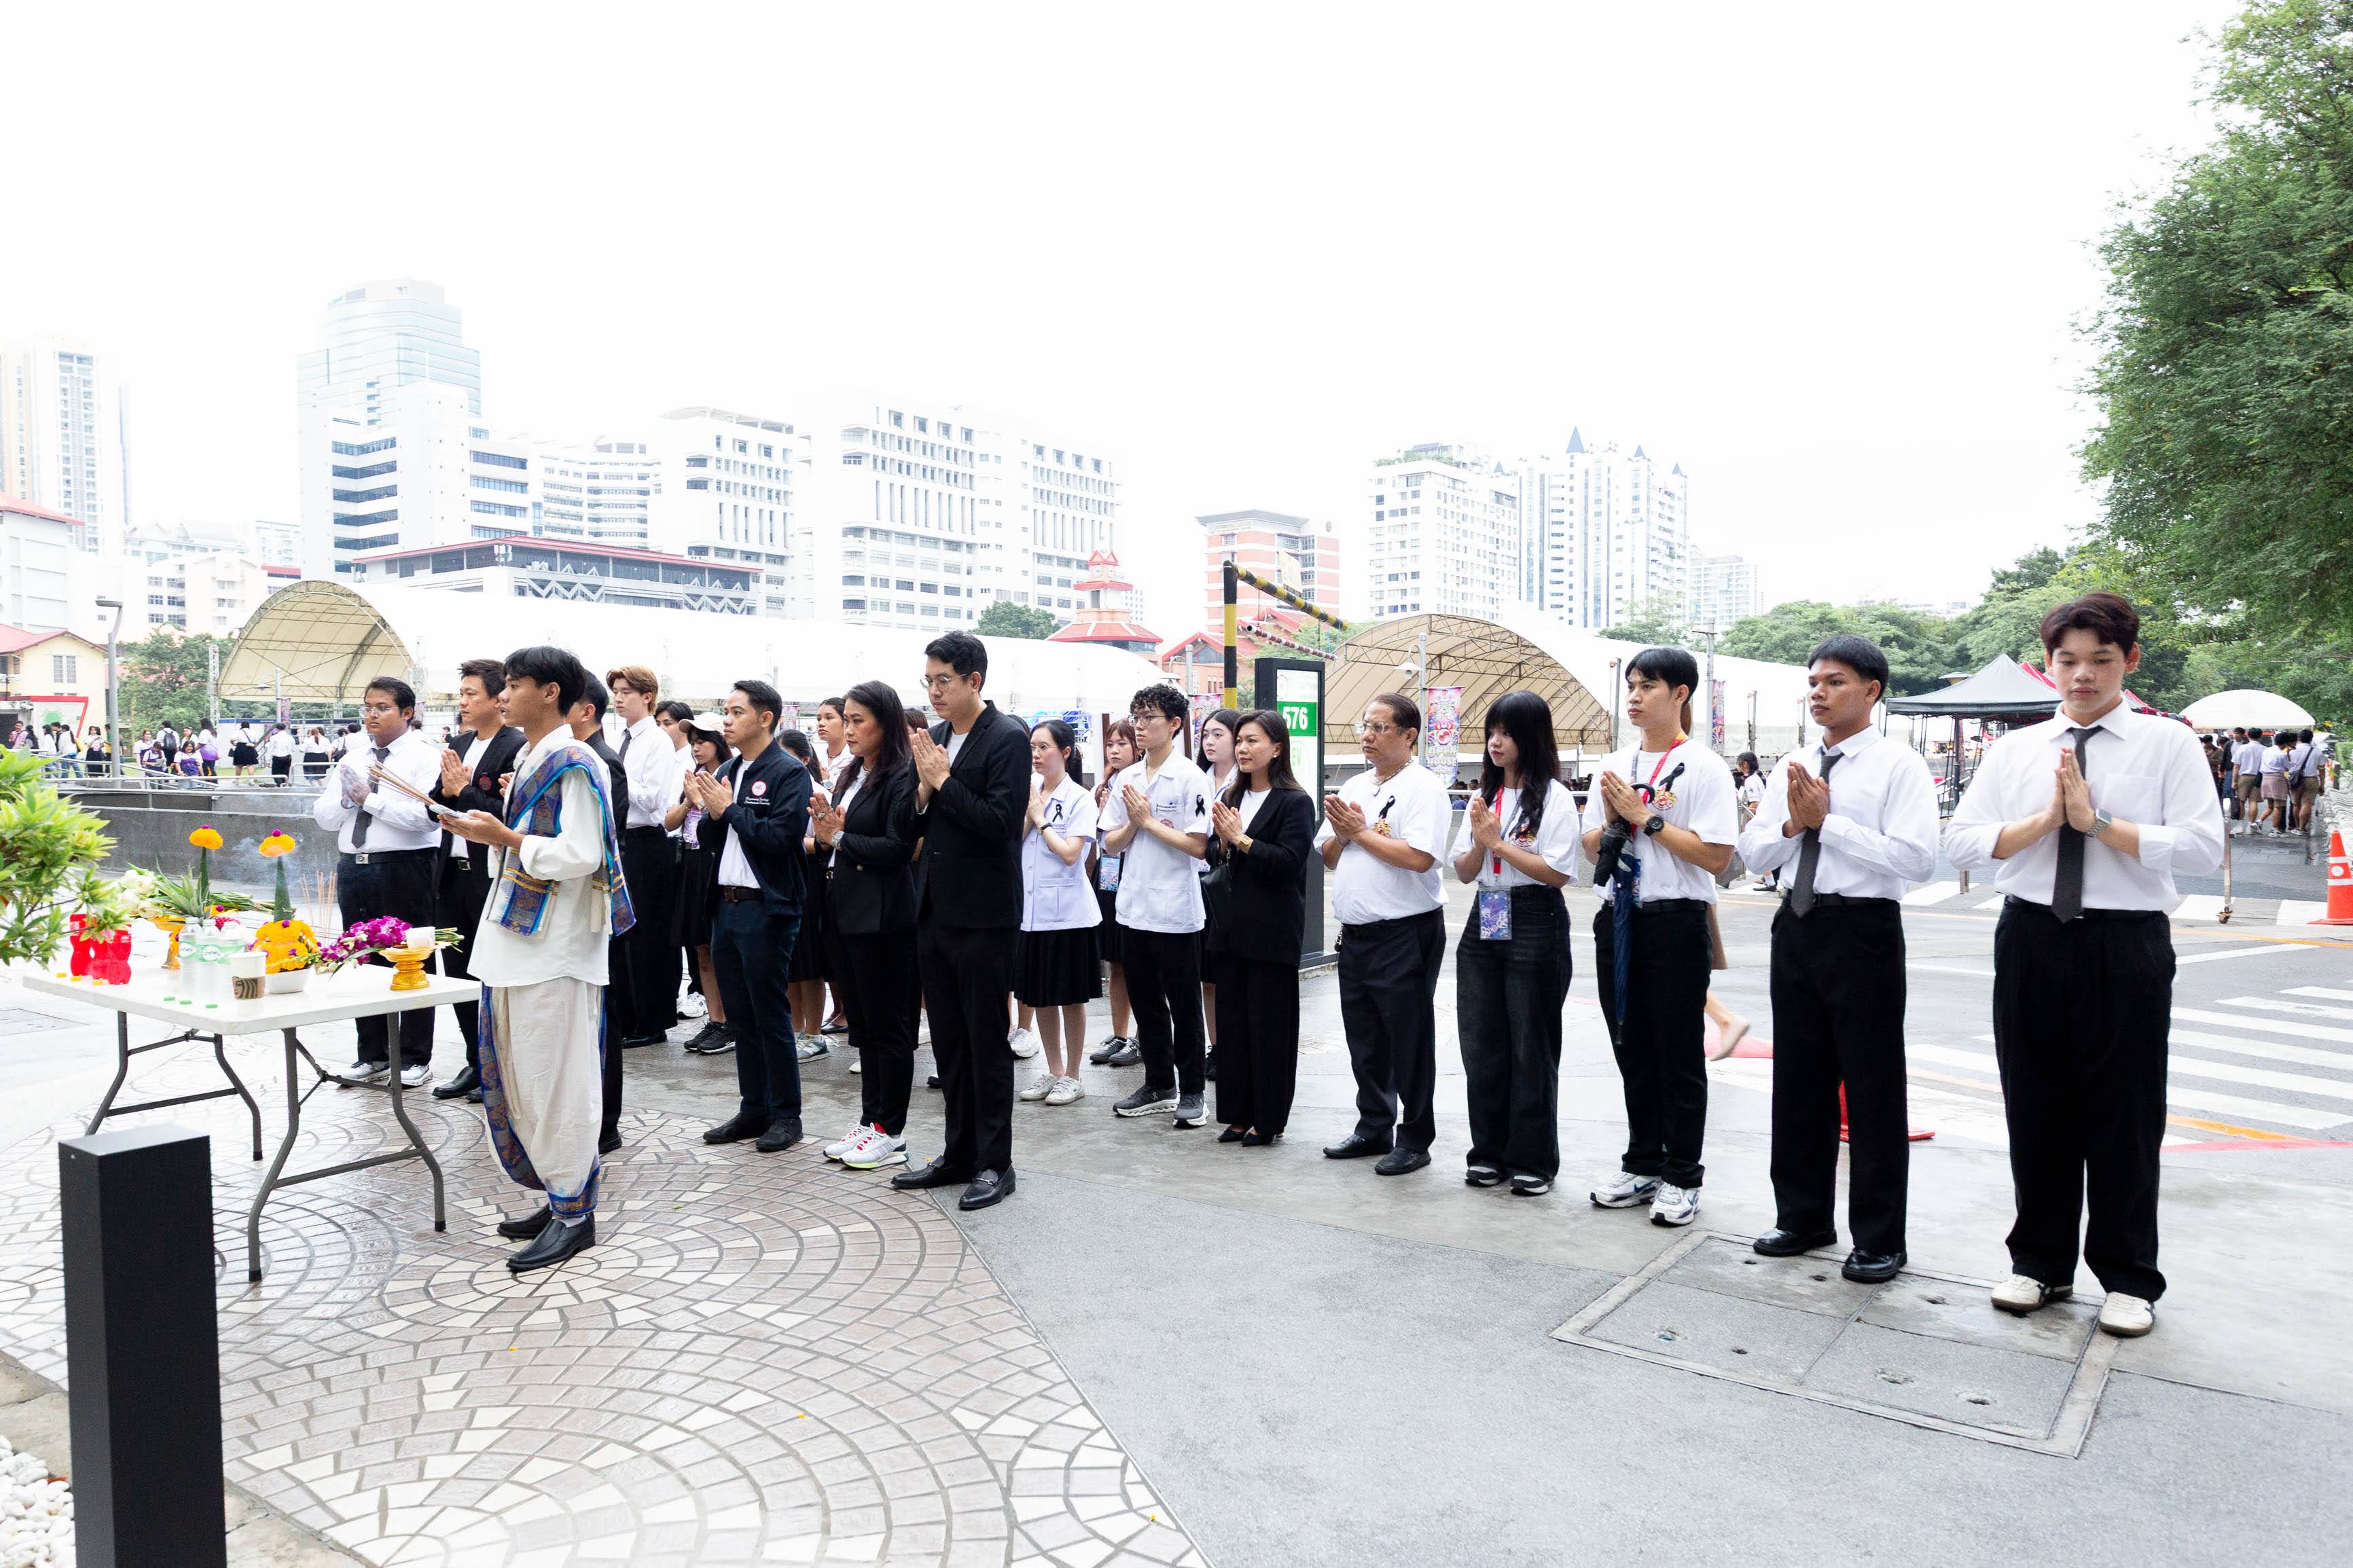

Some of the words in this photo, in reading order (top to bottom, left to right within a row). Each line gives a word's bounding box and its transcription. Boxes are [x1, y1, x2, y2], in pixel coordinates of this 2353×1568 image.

[1282, 706, 1308, 730] 576
[1428, 746, 1456, 758] OPEN
[1427, 756, 1456, 767] HOUSE
